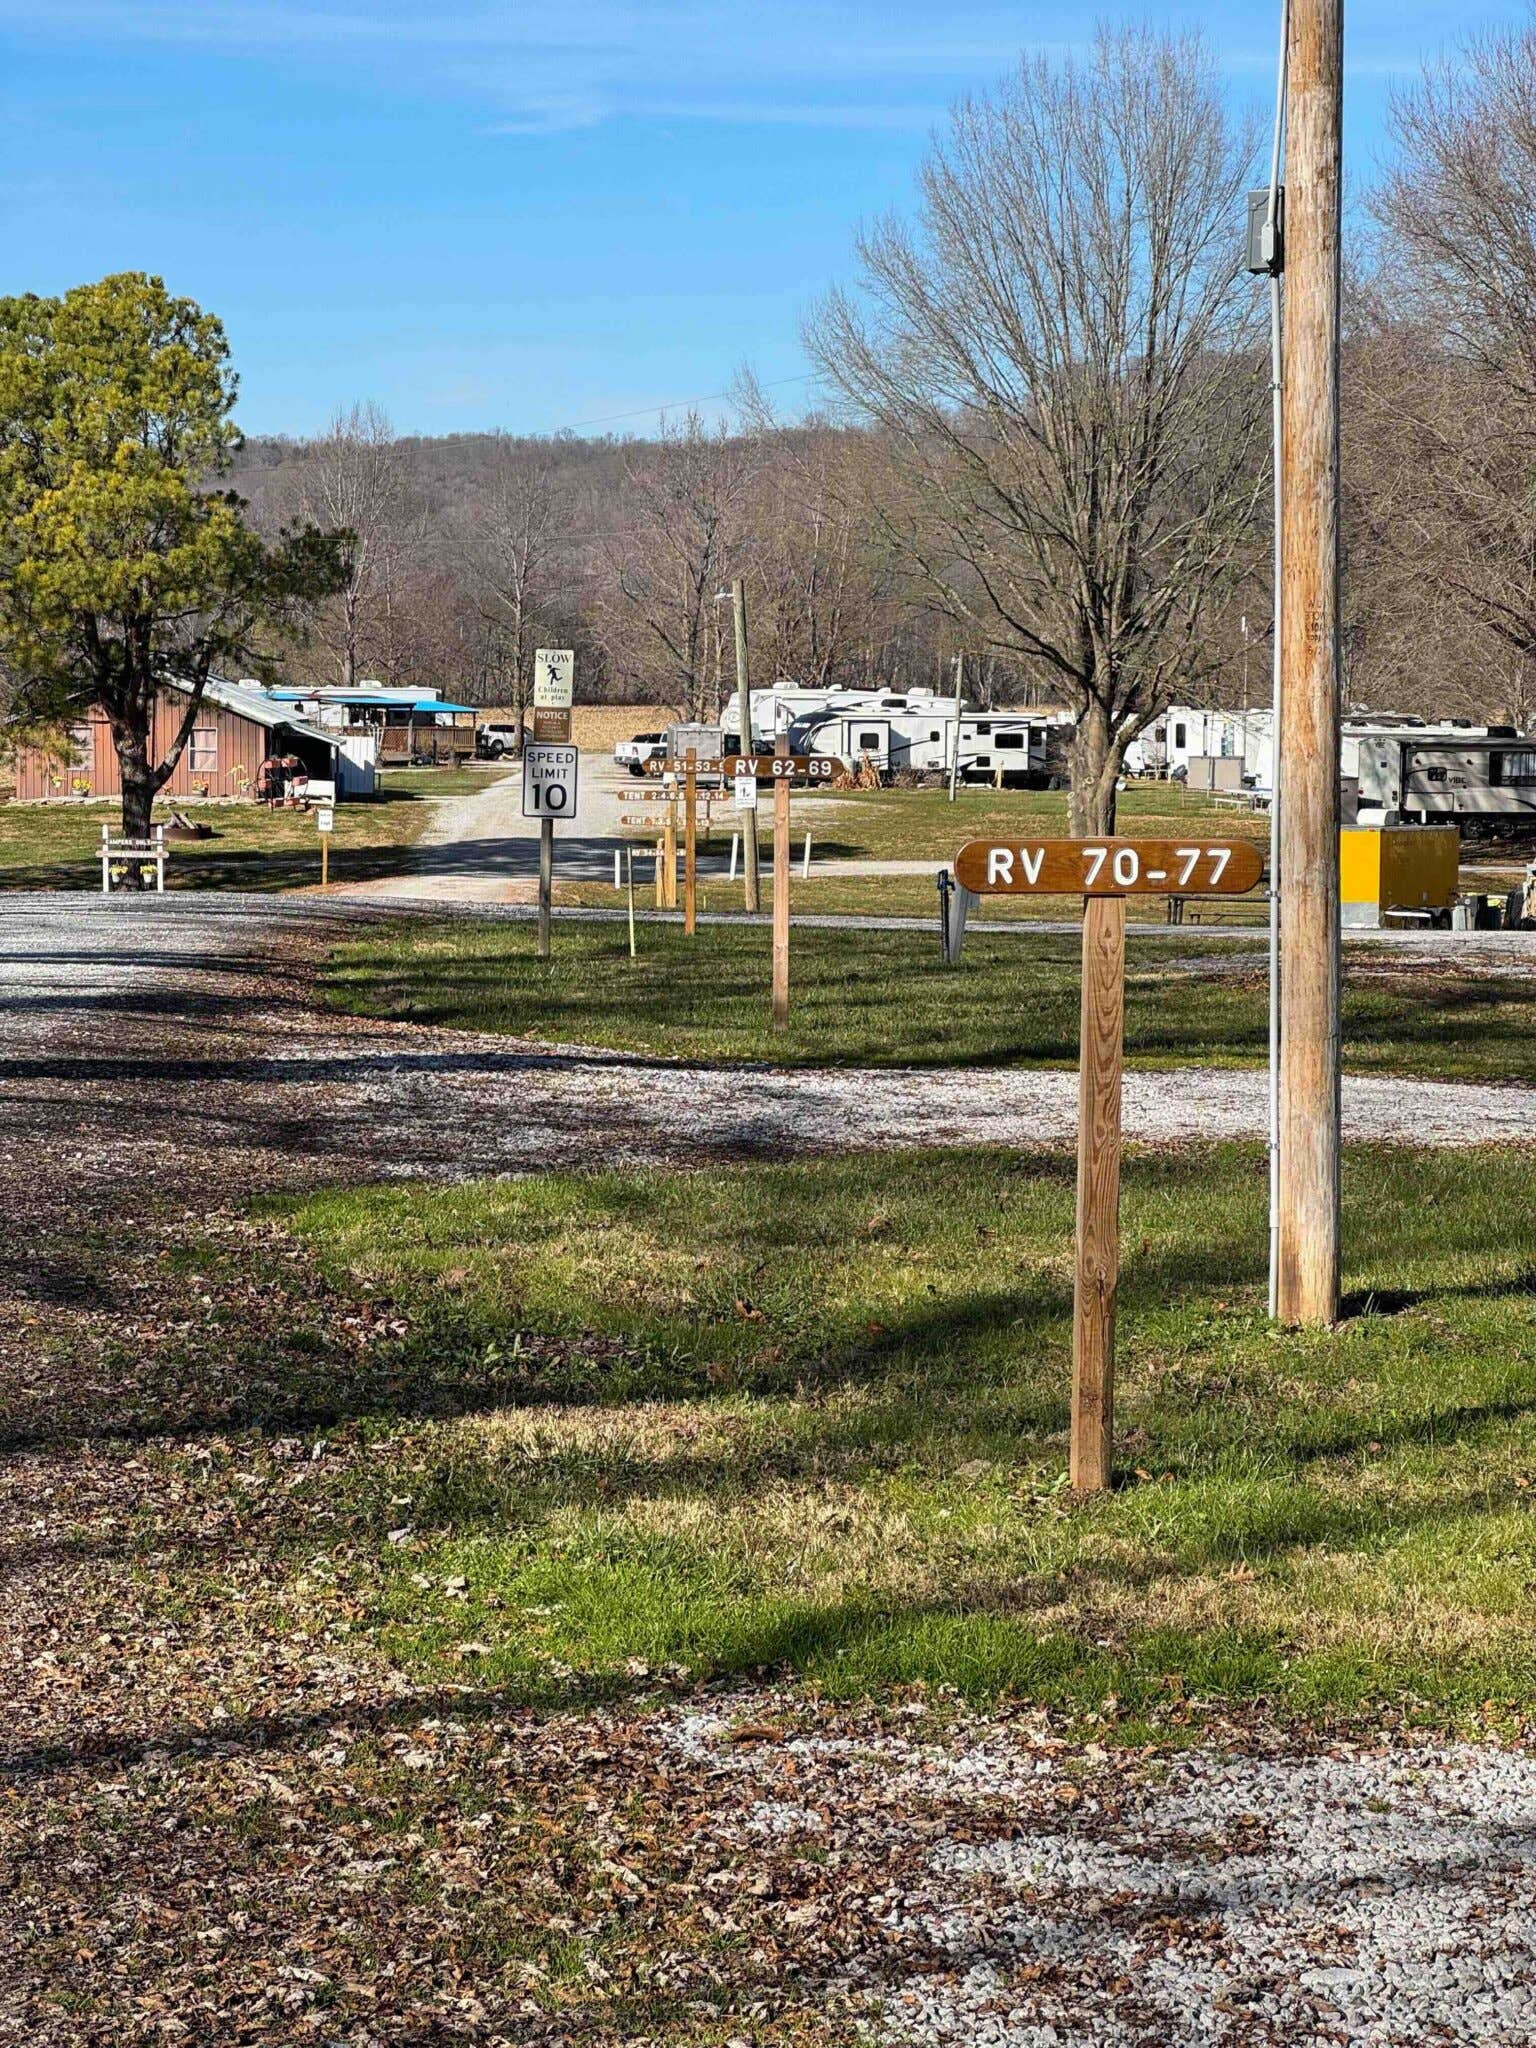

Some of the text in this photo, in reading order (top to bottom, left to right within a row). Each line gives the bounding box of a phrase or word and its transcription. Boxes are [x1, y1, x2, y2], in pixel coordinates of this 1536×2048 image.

[537, 653, 572, 663] SLOW
[536, 710, 569, 720] NOTICE
[527, 752, 574, 764] SPEED
[650, 761, 665, 771] RV
[735, 759, 832, 776] RV 62-69
[531, 767, 568, 779] LIMIT
[532, 783, 567, 811] 10
[624, 791, 645, 800] TENT
[987, 846, 1231, 886] RV 70-77
